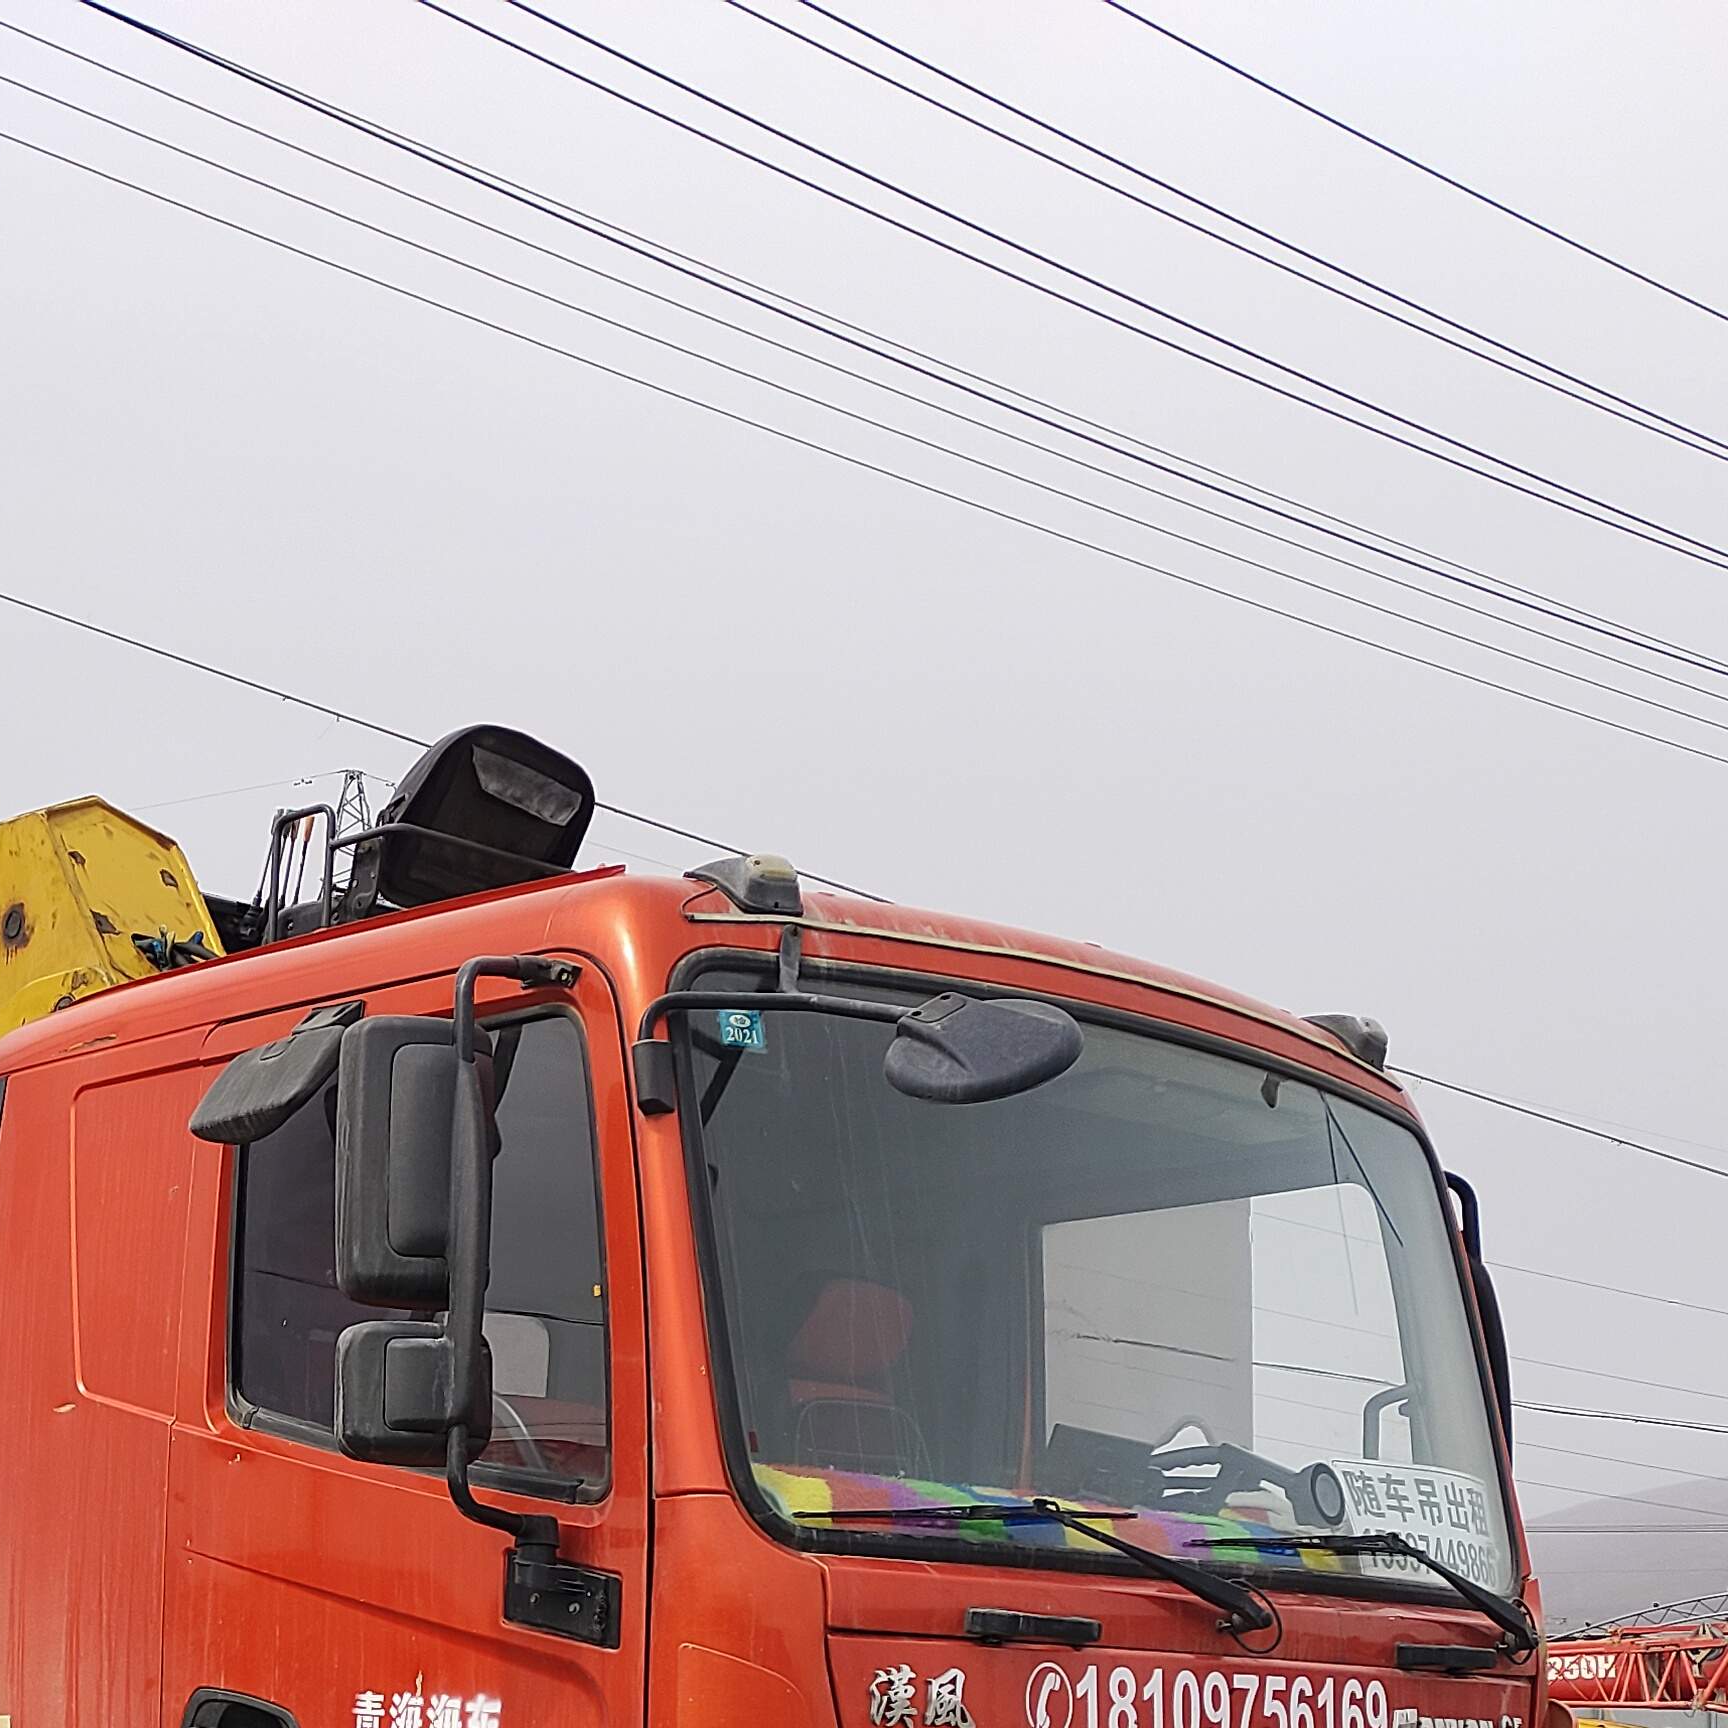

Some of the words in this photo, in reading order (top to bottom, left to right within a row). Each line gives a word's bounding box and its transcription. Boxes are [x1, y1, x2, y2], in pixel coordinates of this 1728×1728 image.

[725, 1027, 759, 1044] 2021
[1342, 1470, 1489, 1537] 随车吊出租
